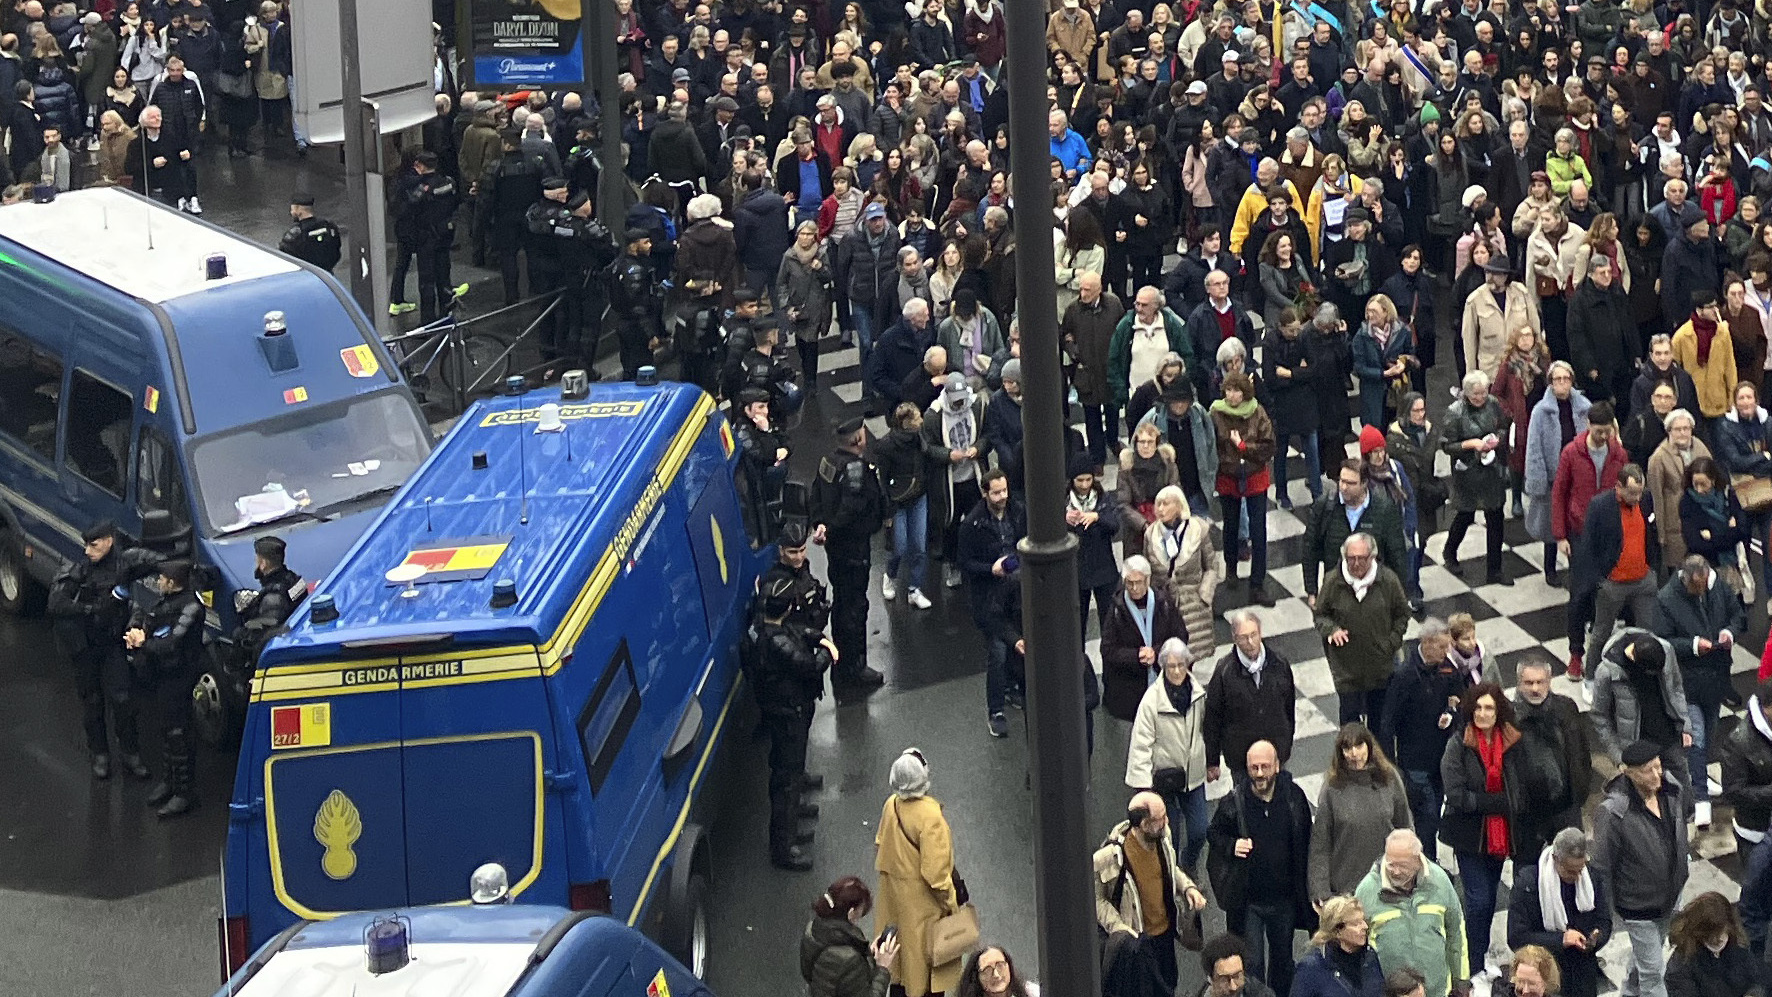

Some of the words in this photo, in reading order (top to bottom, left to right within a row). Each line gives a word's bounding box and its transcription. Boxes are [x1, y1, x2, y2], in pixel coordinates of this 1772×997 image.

[493, 21, 526, 37] DARYL
[528, 21, 559, 37] DIXON
[613, 475, 663, 561] GENDARMERIE
[344, 661, 460, 685] GENDARMERIE
[274, 733, 300, 745] 27/2
